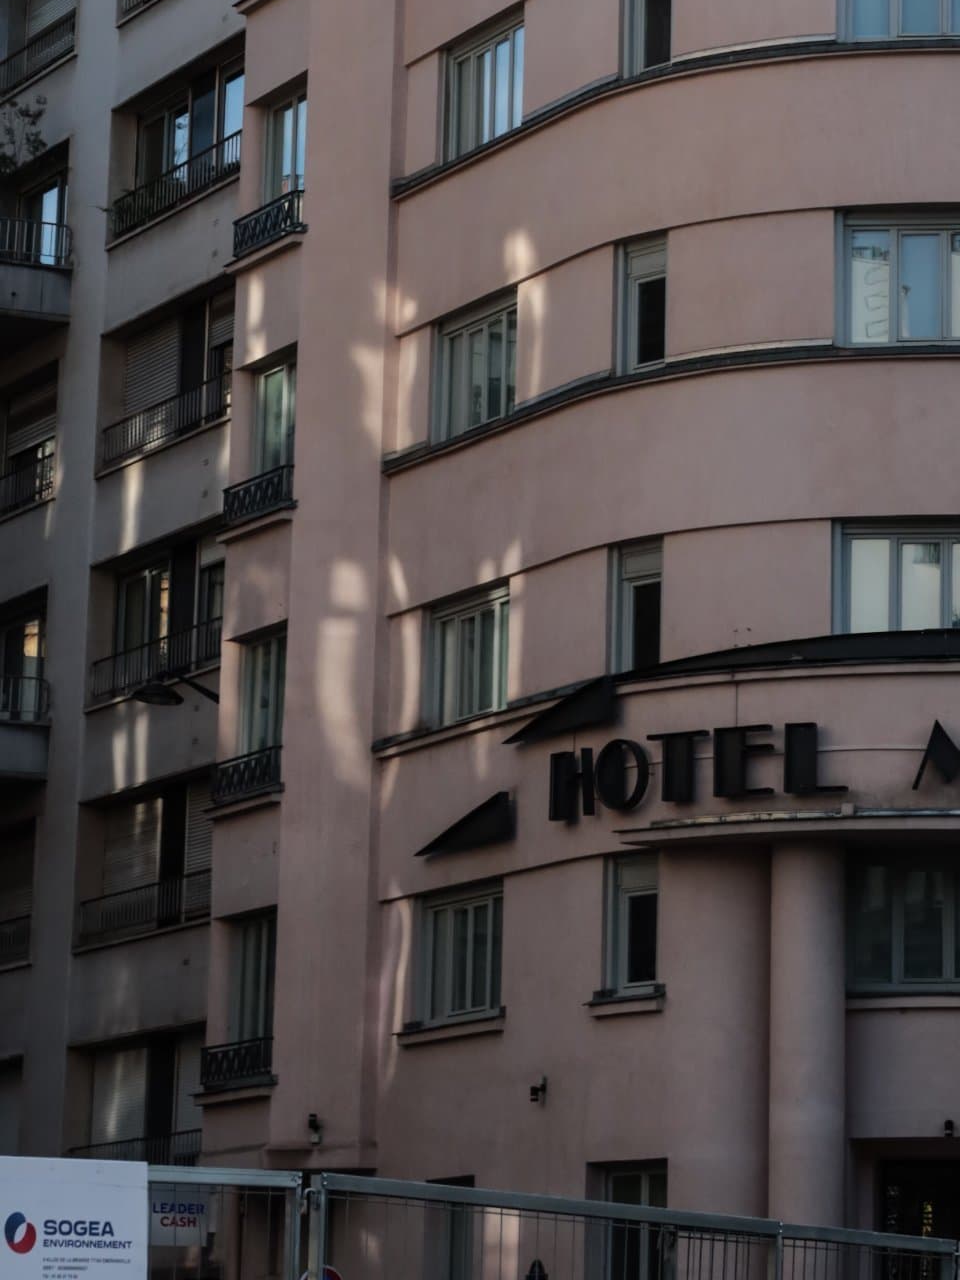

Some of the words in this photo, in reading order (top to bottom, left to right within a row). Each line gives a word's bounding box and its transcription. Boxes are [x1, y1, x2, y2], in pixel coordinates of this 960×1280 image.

[548, 722, 849, 822] HOTEL
[152, 1202, 206, 1215] LEADER
[43, 1219, 115, 1237] SOGEA
[160, 1216, 198, 1228] CASH
[43, 1239, 133, 1249] ENVIRONNEMENT
